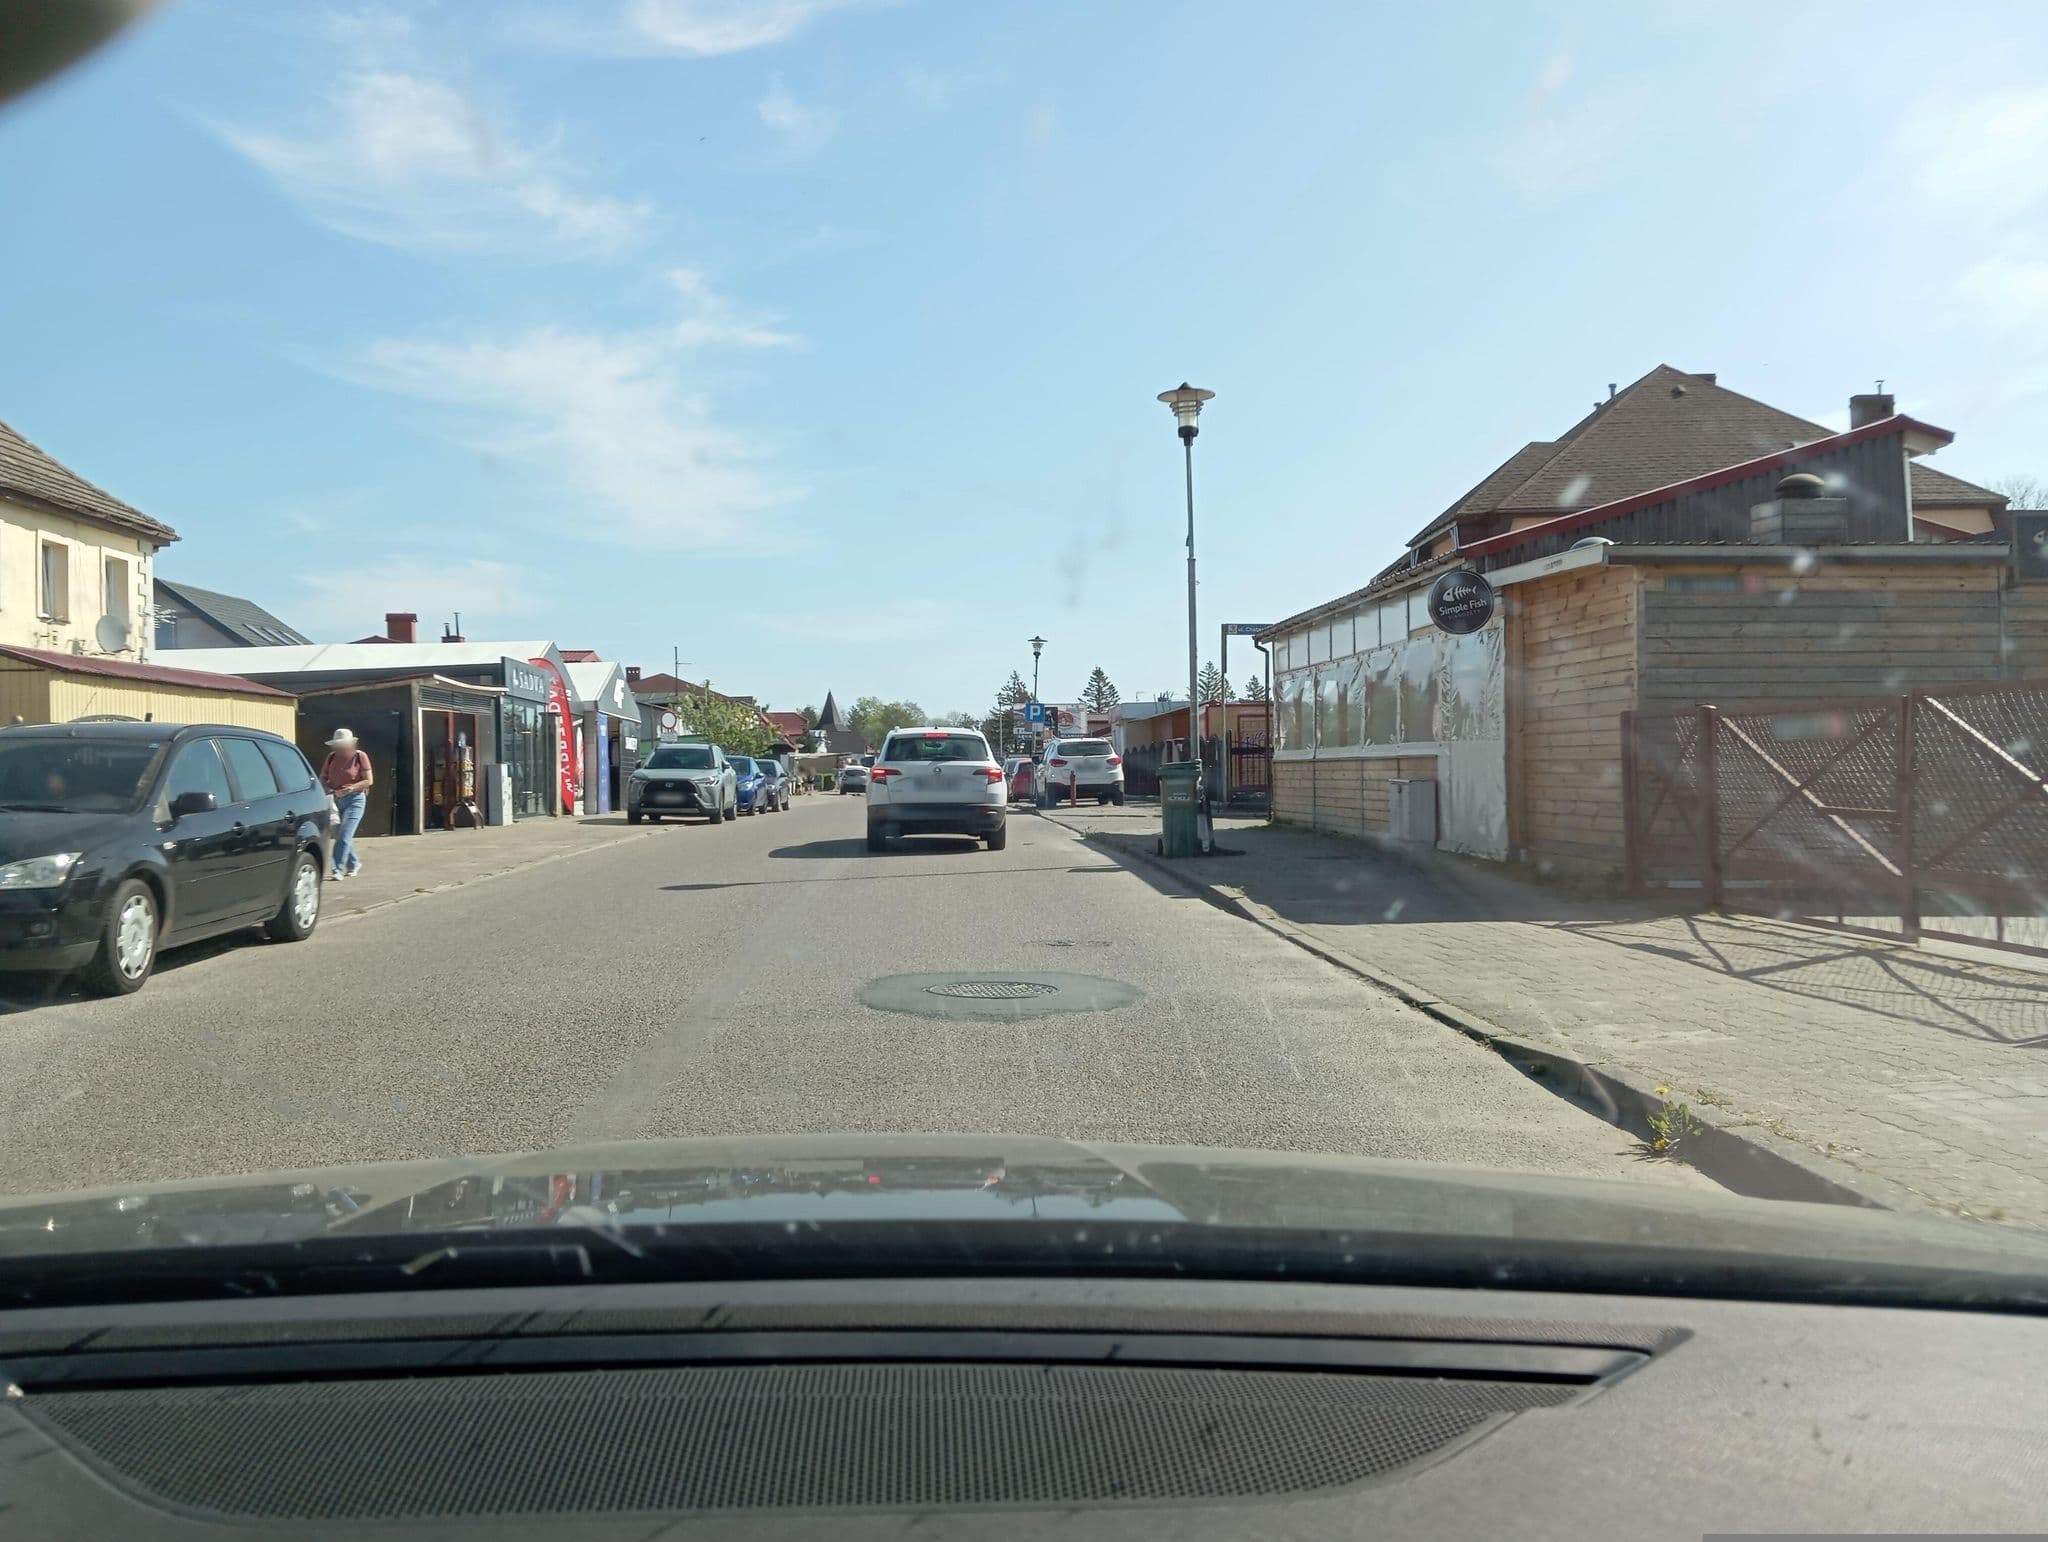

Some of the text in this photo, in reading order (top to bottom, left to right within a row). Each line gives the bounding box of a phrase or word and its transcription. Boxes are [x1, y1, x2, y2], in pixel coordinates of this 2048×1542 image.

[1439, 603, 1468, 616] Simple
[1469, 599, 1487, 609] Fish
[1030, 705, 1041, 720] P
